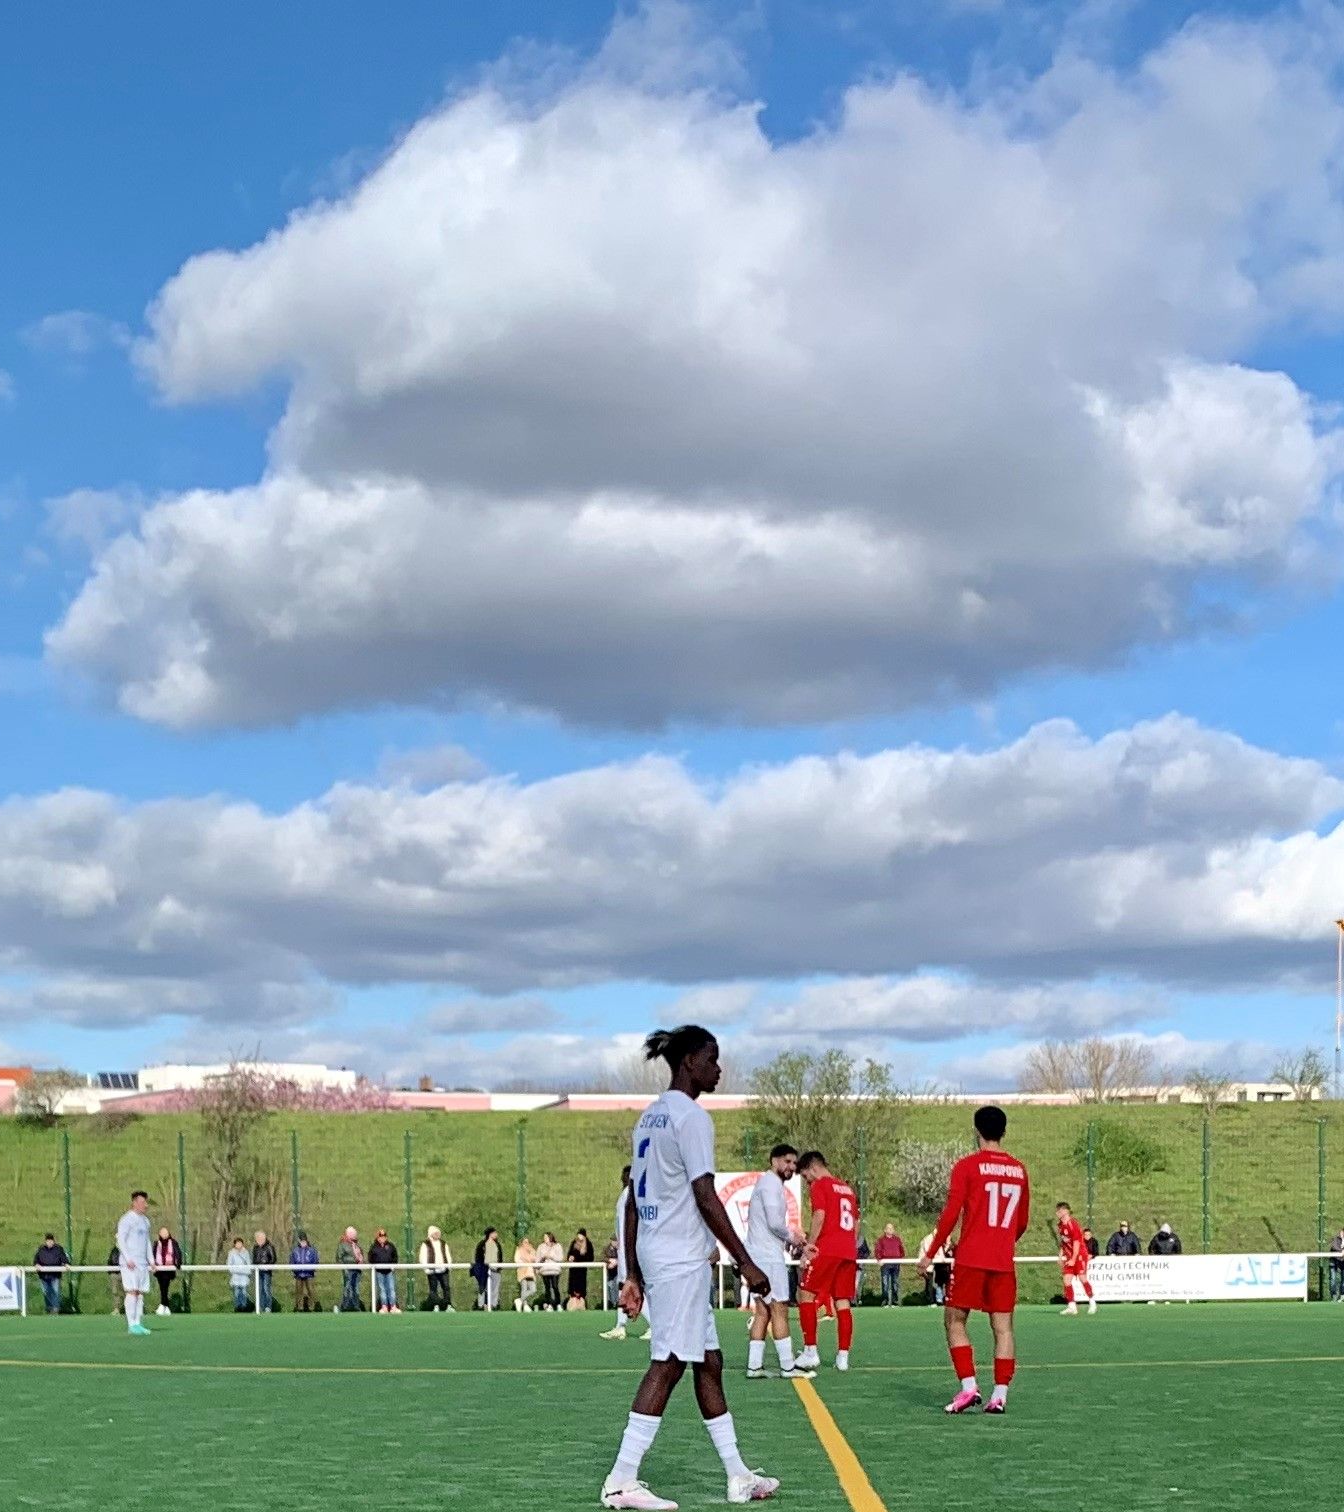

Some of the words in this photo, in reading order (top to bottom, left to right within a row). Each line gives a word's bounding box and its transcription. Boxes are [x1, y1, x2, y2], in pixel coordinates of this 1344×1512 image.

[839, 1197, 854, 1232] 6
[984, 1181, 1022, 1230] 17
[1087, 1261, 1170, 1271] FZUGTECHNIK
[1087, 1273, 1113, 1281] RLIN
[1117, 1273, 1150, 1281] GMBH
[1223, 1254, 1307, 1286] ATB
